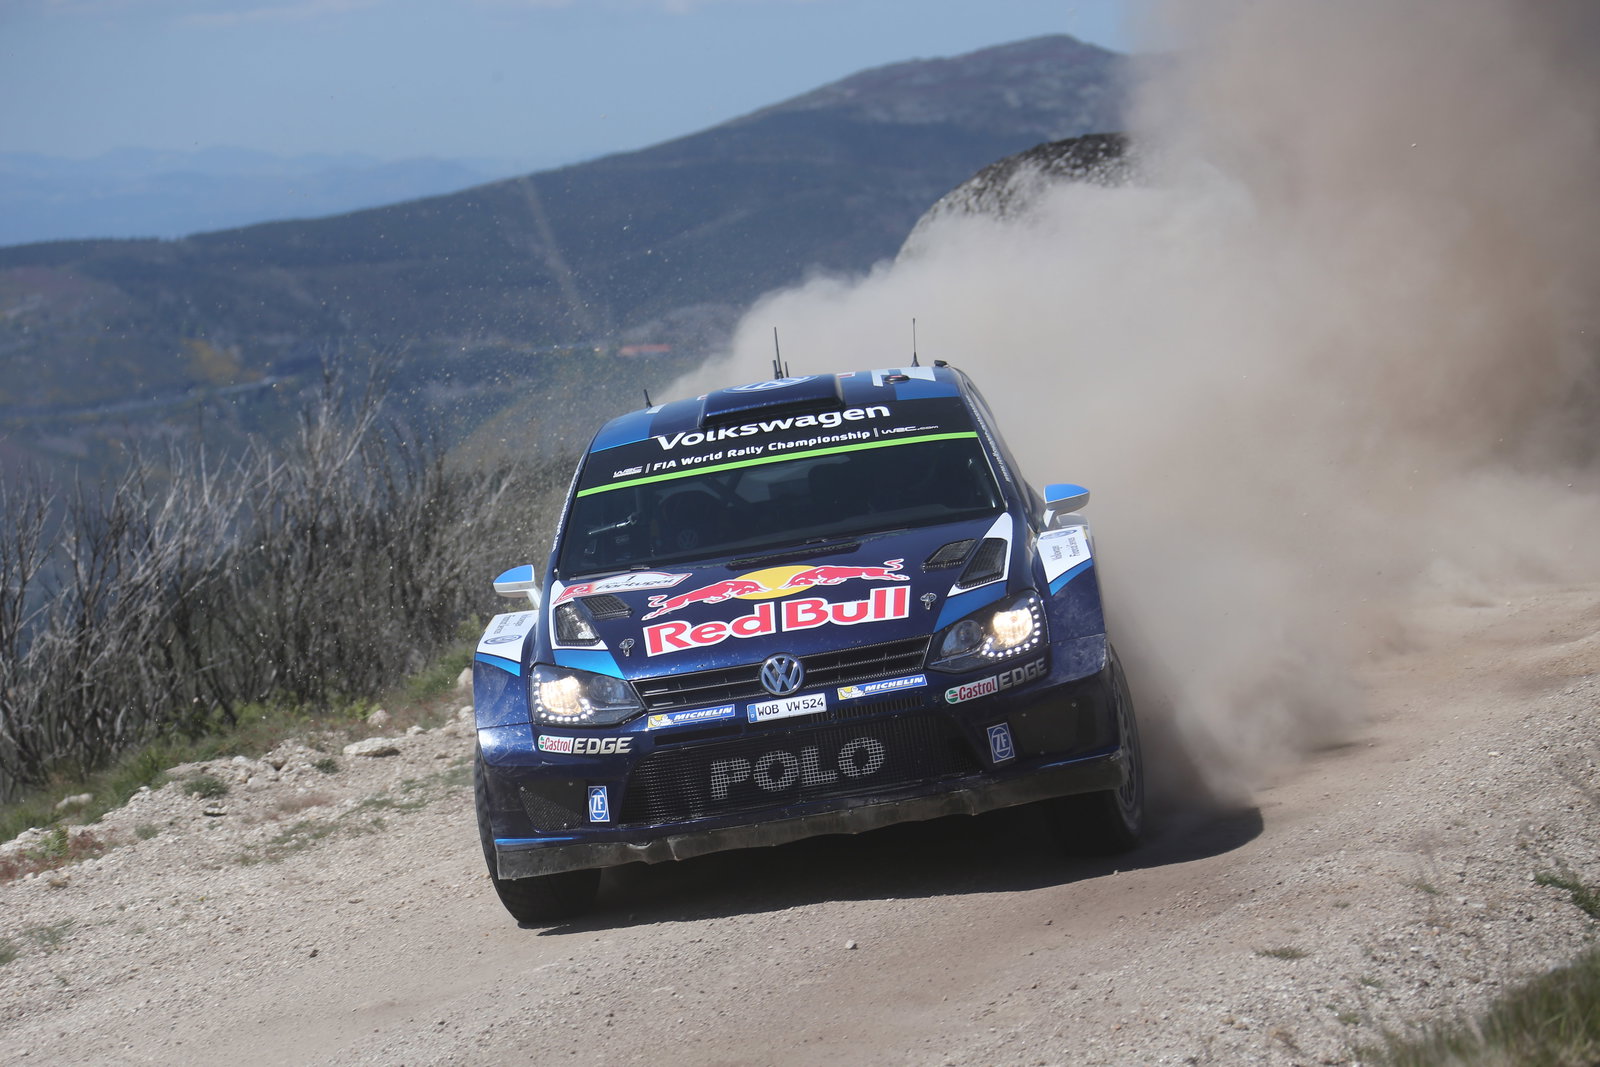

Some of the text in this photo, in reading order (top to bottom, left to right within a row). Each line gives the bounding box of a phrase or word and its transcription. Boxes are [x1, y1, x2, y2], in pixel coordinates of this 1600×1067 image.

[653, 460, 677, 471] FIA
[681, 451, 722, 466] World
[727, 446, 764, 458] Rally
[768, 431, 871, 450] Championship
[644, 586, 910, 656] Red Bull
[865, 675, 923, 691] MICHELIN
[959, 658, 1048, 700] Castrol EDGE
[674, 706, 733, 721] MICHELIN
[757, 704, 780, 717] WOB
[785, 701, 801, 713] VW
[802, 698, 824, 710] 524
[544, 737, 634, 754] Castrol EDGE
[993, 732, 1010, 753] ZF
[710, 737, 885, 800] POLO
[591, 794, 606, 813] ZF
